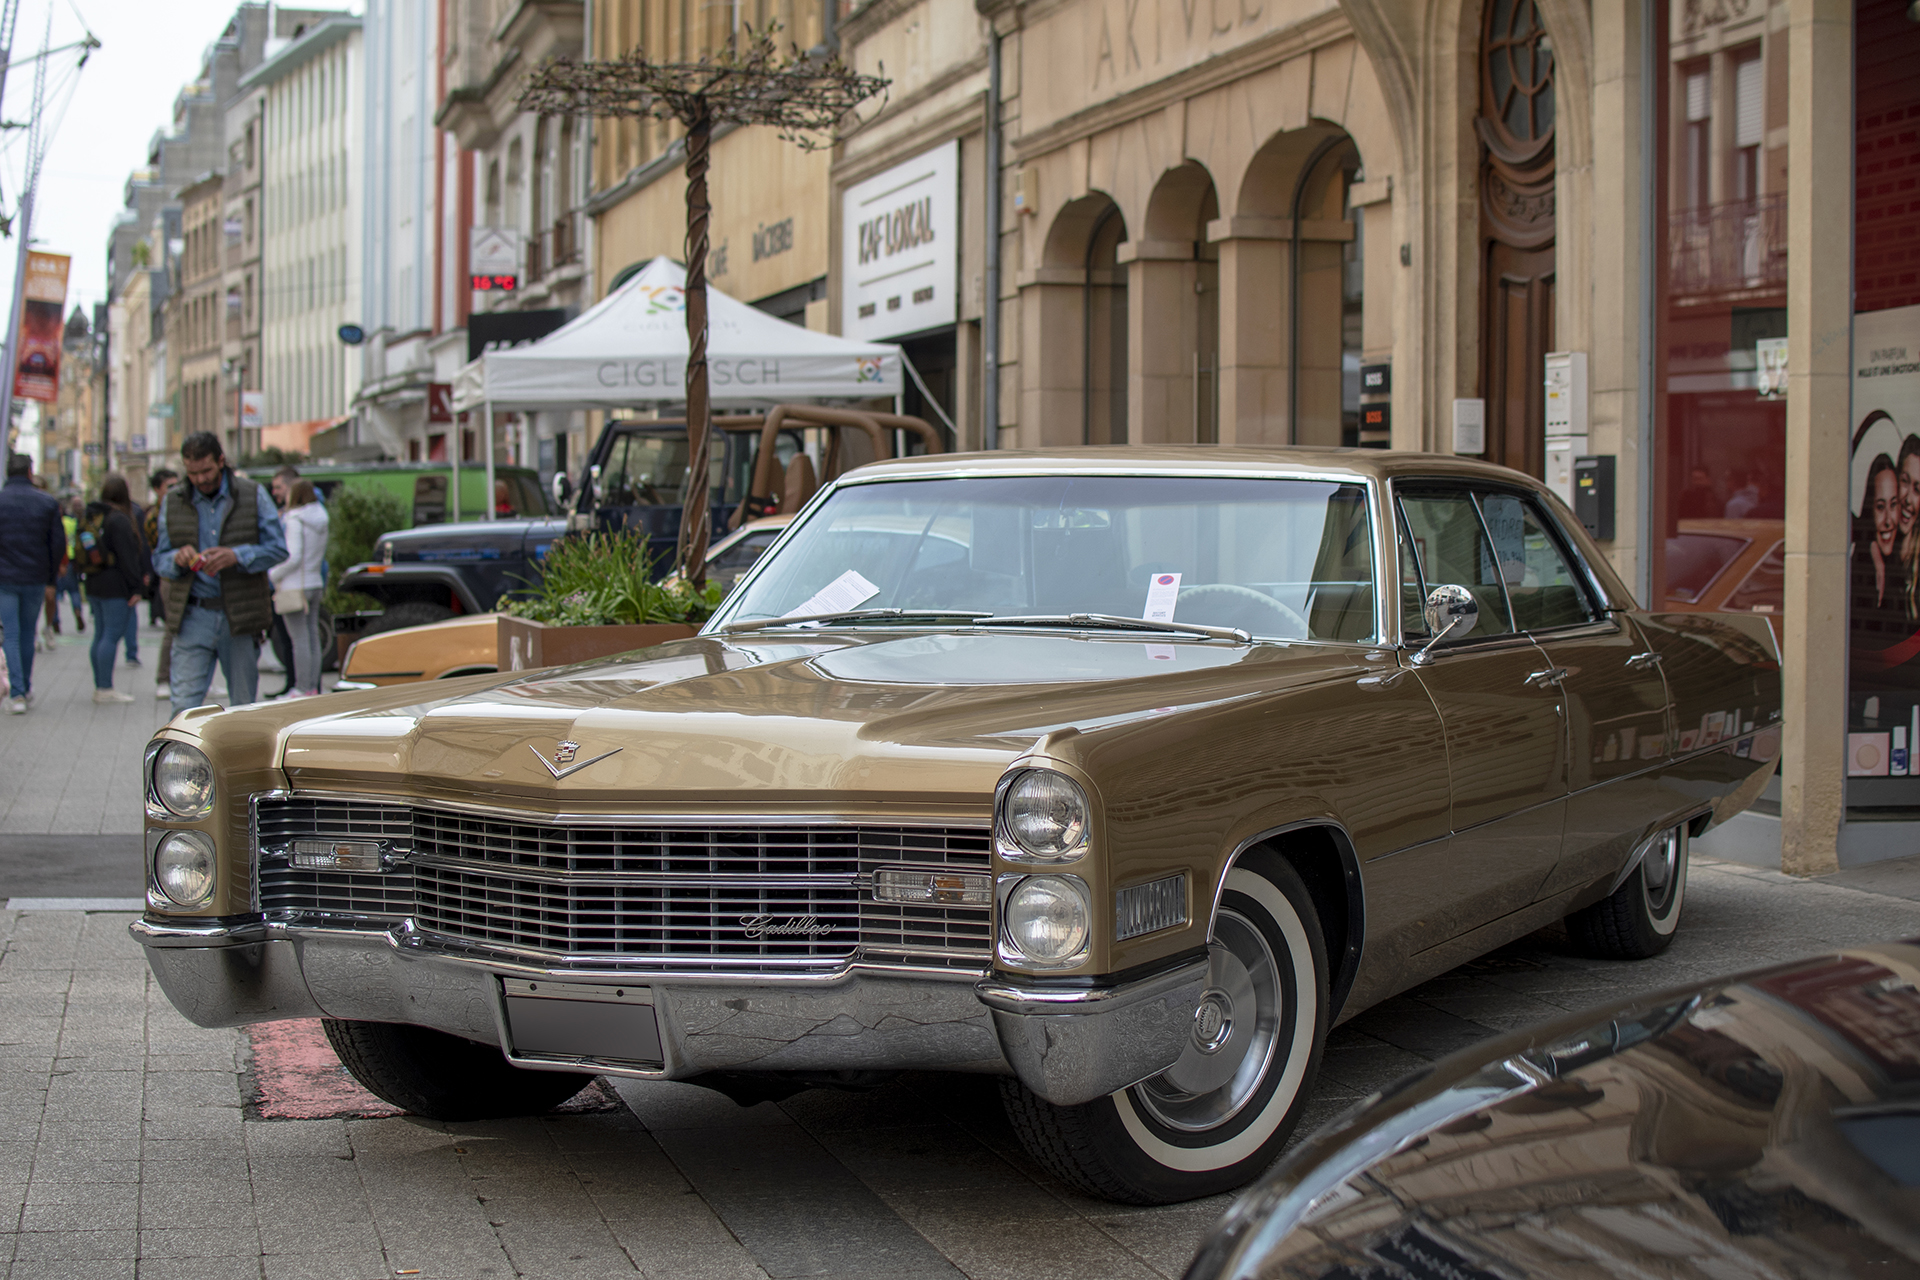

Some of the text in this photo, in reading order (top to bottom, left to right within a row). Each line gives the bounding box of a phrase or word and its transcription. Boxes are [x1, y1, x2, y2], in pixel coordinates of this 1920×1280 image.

[858, 196, 935, 266] KAF LOKAL
[597, 359, 781, 388] CIGL SCH
[739, 914, 837, 939] Cadillac
